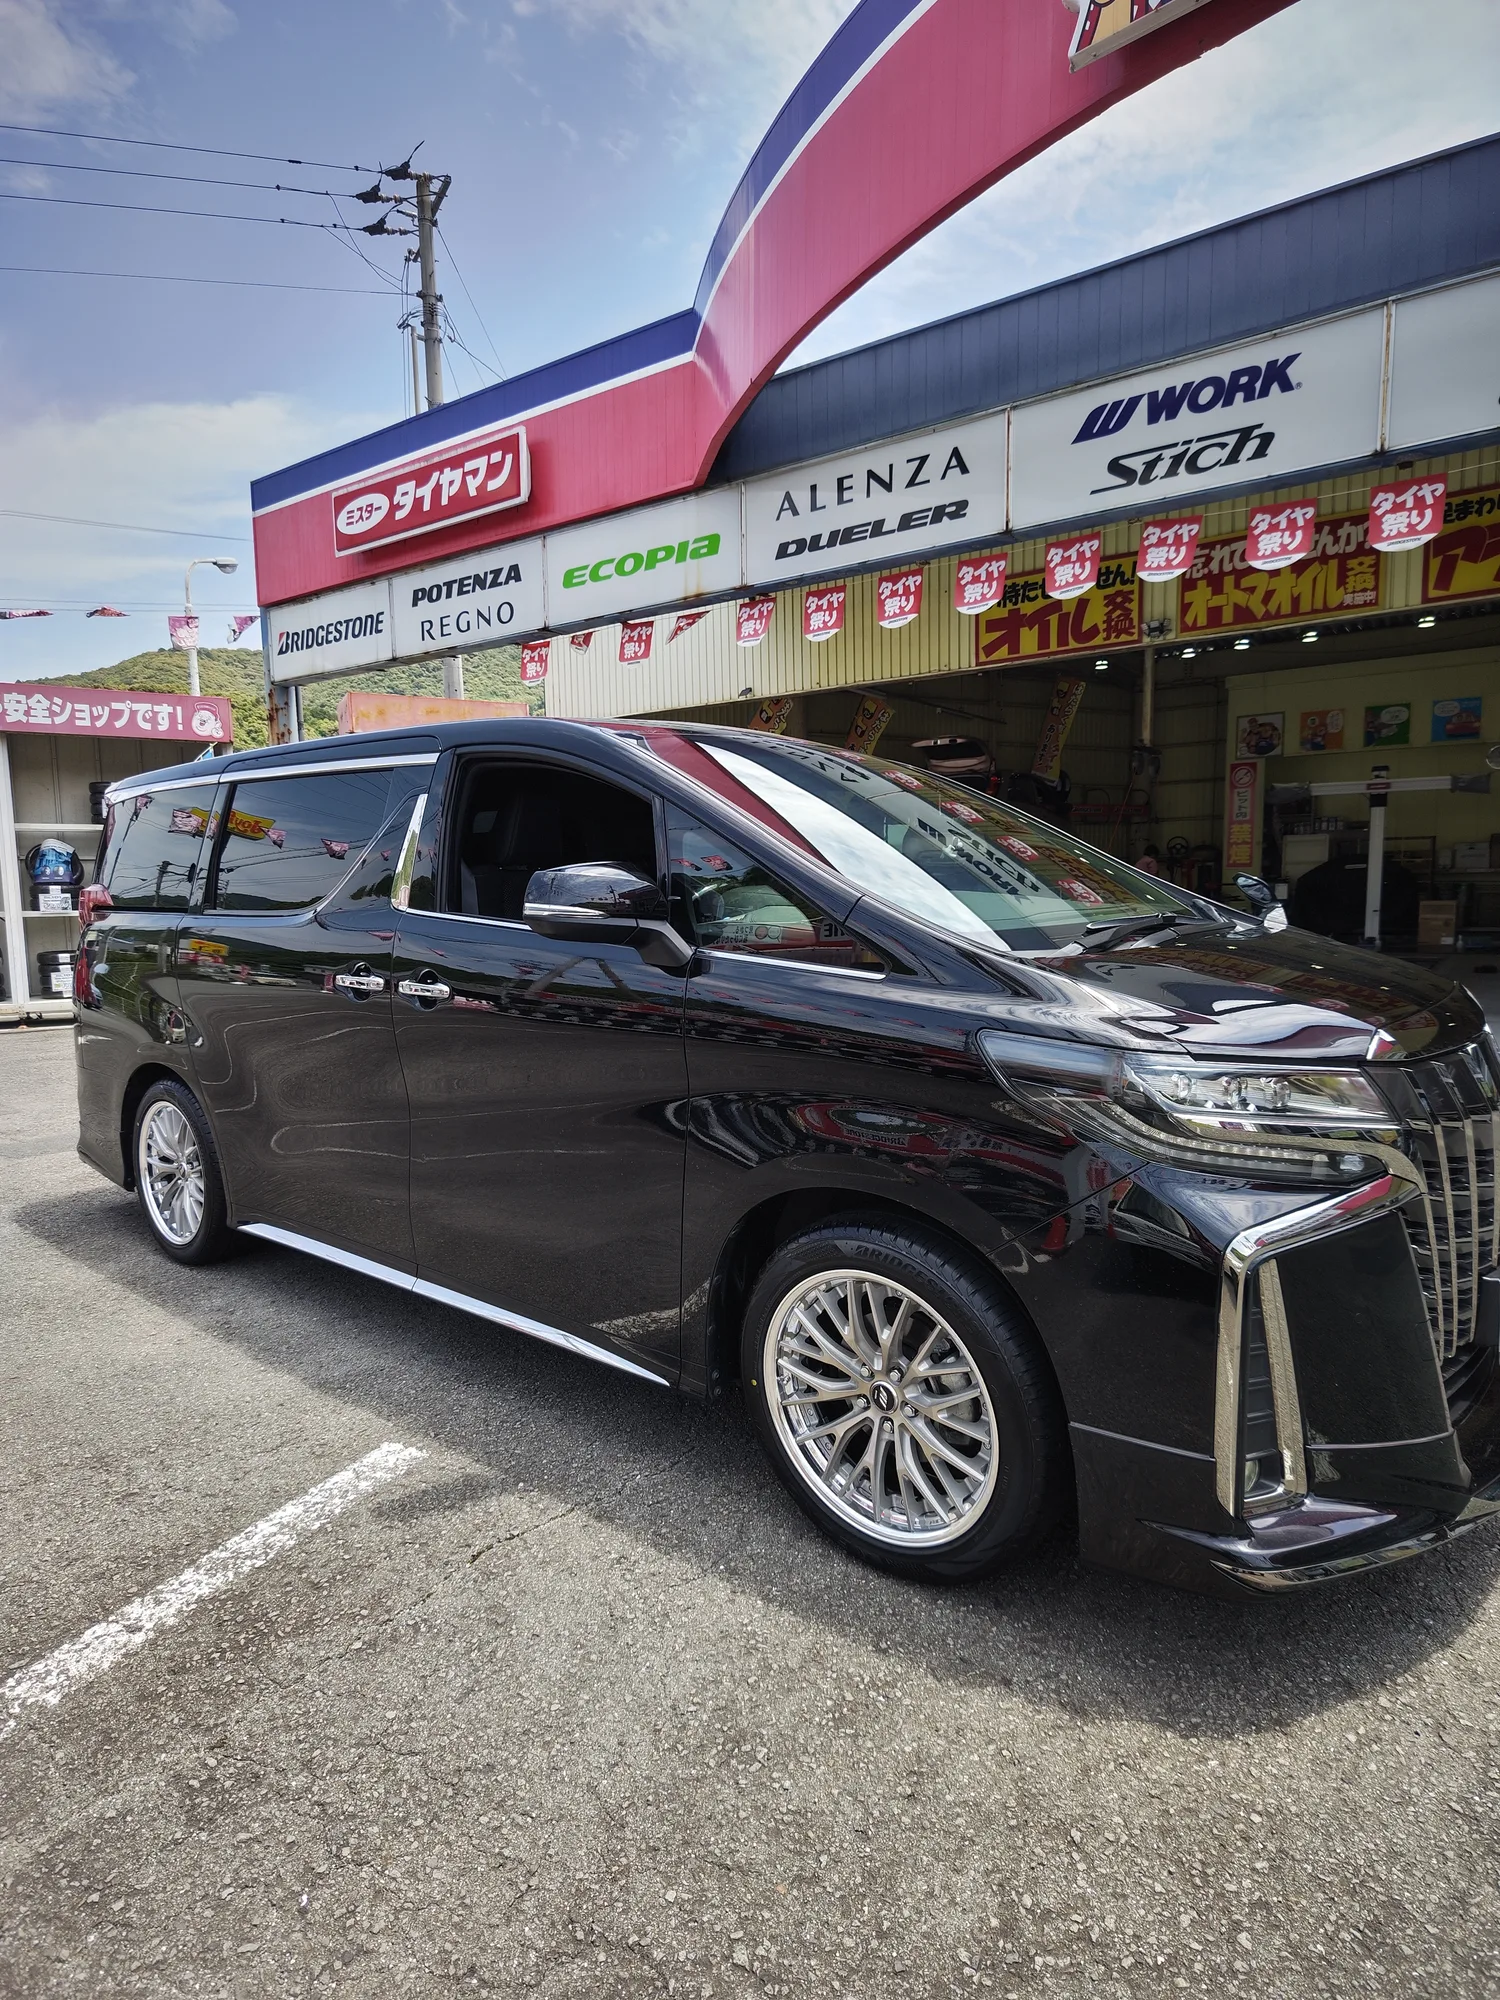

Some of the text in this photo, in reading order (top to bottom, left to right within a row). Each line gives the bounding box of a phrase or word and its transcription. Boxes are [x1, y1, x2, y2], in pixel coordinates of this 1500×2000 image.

[1145, 352, 1302, 425] WORK
[1090, 423, 1276, 495] Stich
[345, 450, 513, 527] ミスター タイヤマン
[775, 445, 970, 521] ALENZA
[1371, 482, 1445, 516] タイヤ
[775, 499, 969, 561] DUELER
[1143, 523, 1199, 546] タイヤ
[1250, 506, 1315, 536] タイヤ
[1381, 509, 1433, 538] 祭り
[1046, 538, 1100, 568] タイヤ
[1145, 545, 1186, 569] 祭り
[1257, 529, 1303, 557] 祭り
[411, 563, 522, 608] POTENZA
[958, 559, 1006, 585] タイヤ
[1054, 560, 1091, 587] 祭り
[806, 591, 845, 612] タイヤ
[878, 574, 922, 600] タイヤ
[964, 580, 998, 603] 祭り
[1184, 559, 1345, 627] オートマオイル
[738, 600, 774, 623] タイヤ
[810, 609, 837, 630] 祭り
[884, 595, 915, 617] 祭り
[1103, 589, 1136, 642] 交換
[277, 611, 385, 656] BRIDGESTONE
[420, 601, 515, 642] REGNO
[621, 626, 652, 643] タイヤ
[741, 618, 766, 638] 祭り
[981, 598, 1100, 659] オイル
[522, 646, 549, 663] タイヤ
[623, 641, 646, 659] 祭り
[526, 661, 545, 678] 祭り
[0, 692, 184, 731] 安全ショップです!
[1229, 823, 1252, 864] 禁煙
